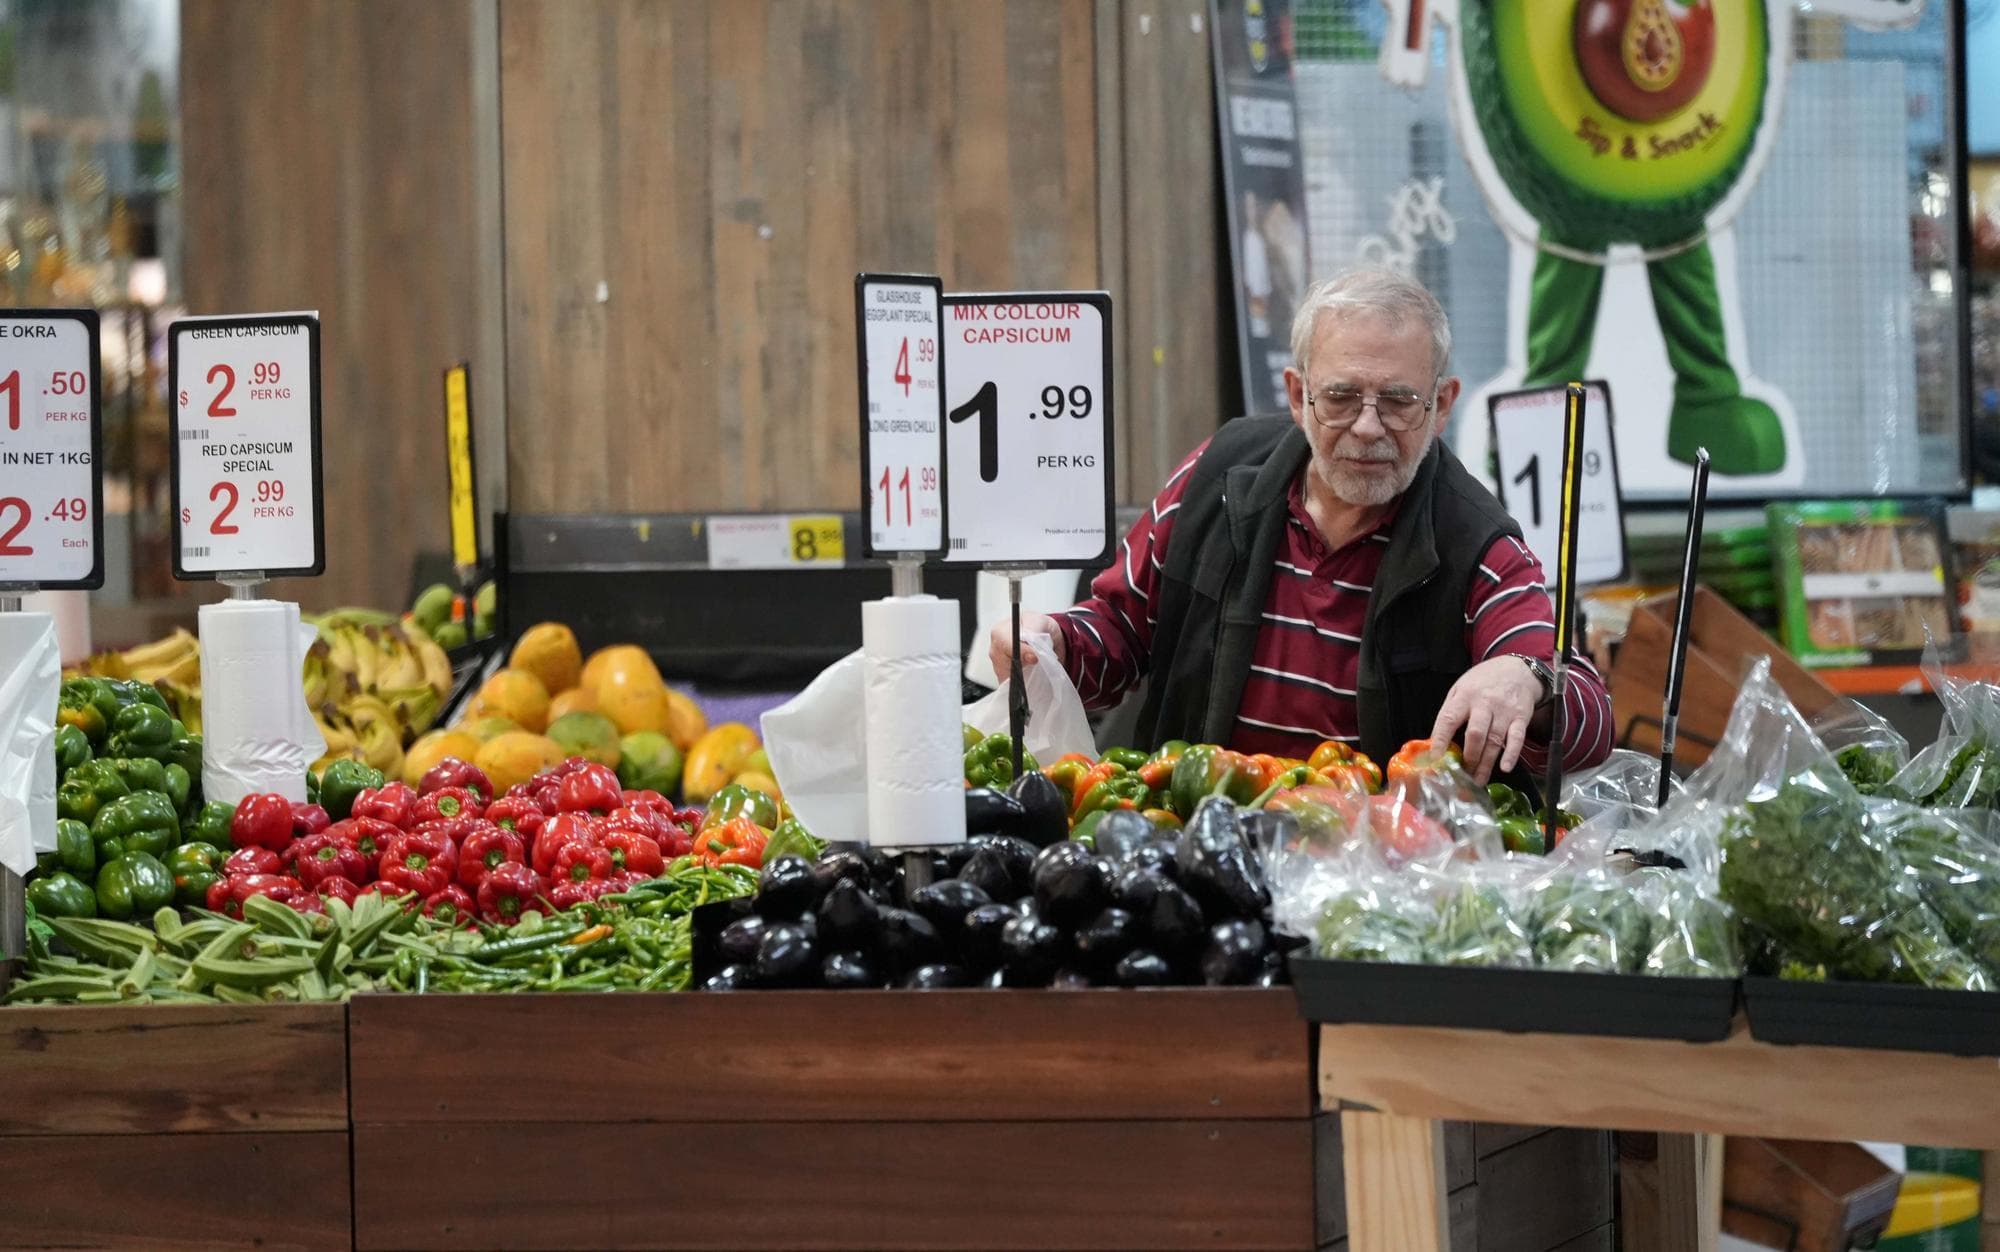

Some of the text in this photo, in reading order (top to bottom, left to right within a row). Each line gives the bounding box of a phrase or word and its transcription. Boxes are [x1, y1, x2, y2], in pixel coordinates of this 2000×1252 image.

[1575, 113, 1722, 160] Sip & Snack
[876, 290, 922, 304] GLASSHOUSE
[866, 309, 934, 323] EGGPLANT SPECIAL
[953, 303, 1080, 320] MIX COLOUR
[12, 325, 57, 338] OKRA
[191, 324, 300, 339] GREEN CAPSICUM
[963, 327, 1071, 344] CAPSICUM
[895, 336, 935, 398] 4 .99
[179, 362, 281, 417] $ 2 .99
[251, 388, 291, 400] PER KG
[0, 369, 86, 431] 1 .50
[46, 411, 87, 421] PER KG
[869, 420, 936, 433] LONG GREEN CHILLI
[949, 381, 1093, 483] 1 .99
[202, 441, 293, 457] RED CAPSICUM
[3, 452, 92, 465] IN NET 1KG
[222, 459, 275, 473] SPECIAL
[1037, 455, 1096, 468] PER KG
[879, 465, 936, 528] 11 .99
[1513, 452, 1542, 528] 1
[182, 479, 285, 535] $ 2 .99
[254, 505, 294, 518] PER KG
[0, 496, 87, 556] 2 .49
[1045, 527, 1071, 536] Produce
[62, 538, 89, 549] Each
[795, 528, 818, 560] 8
